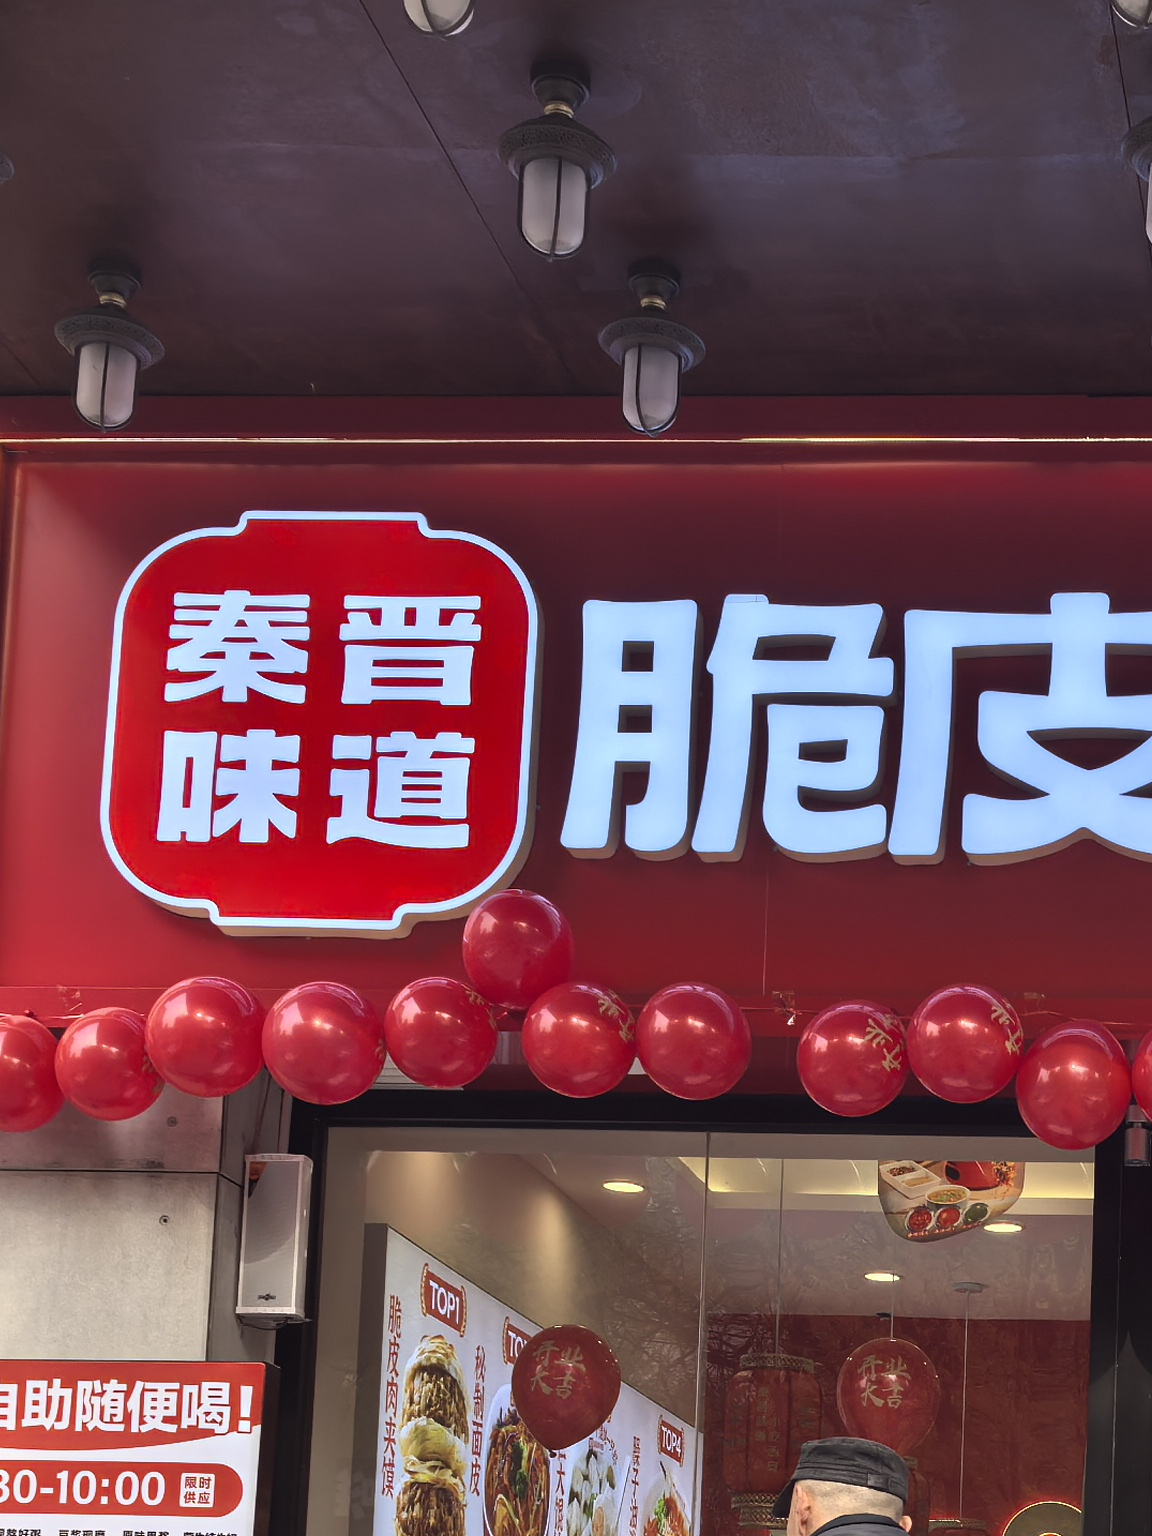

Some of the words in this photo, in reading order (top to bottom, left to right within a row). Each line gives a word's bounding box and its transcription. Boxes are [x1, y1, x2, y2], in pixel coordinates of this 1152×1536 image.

[164, 590, 482, 706] 秦晋
[156, 729, 475, 849] 味道
[429, 1279, 461, 1325] TOP1
[508, 1330, 528, 1358] TO
[382, 1294, 402, 1499] 脆皮肉夹馍
[661, 1426, 682, 1458] TOP4
[183, 1491, 212, 1505] 供应
[184, 1476, 212, 1490] 限时
